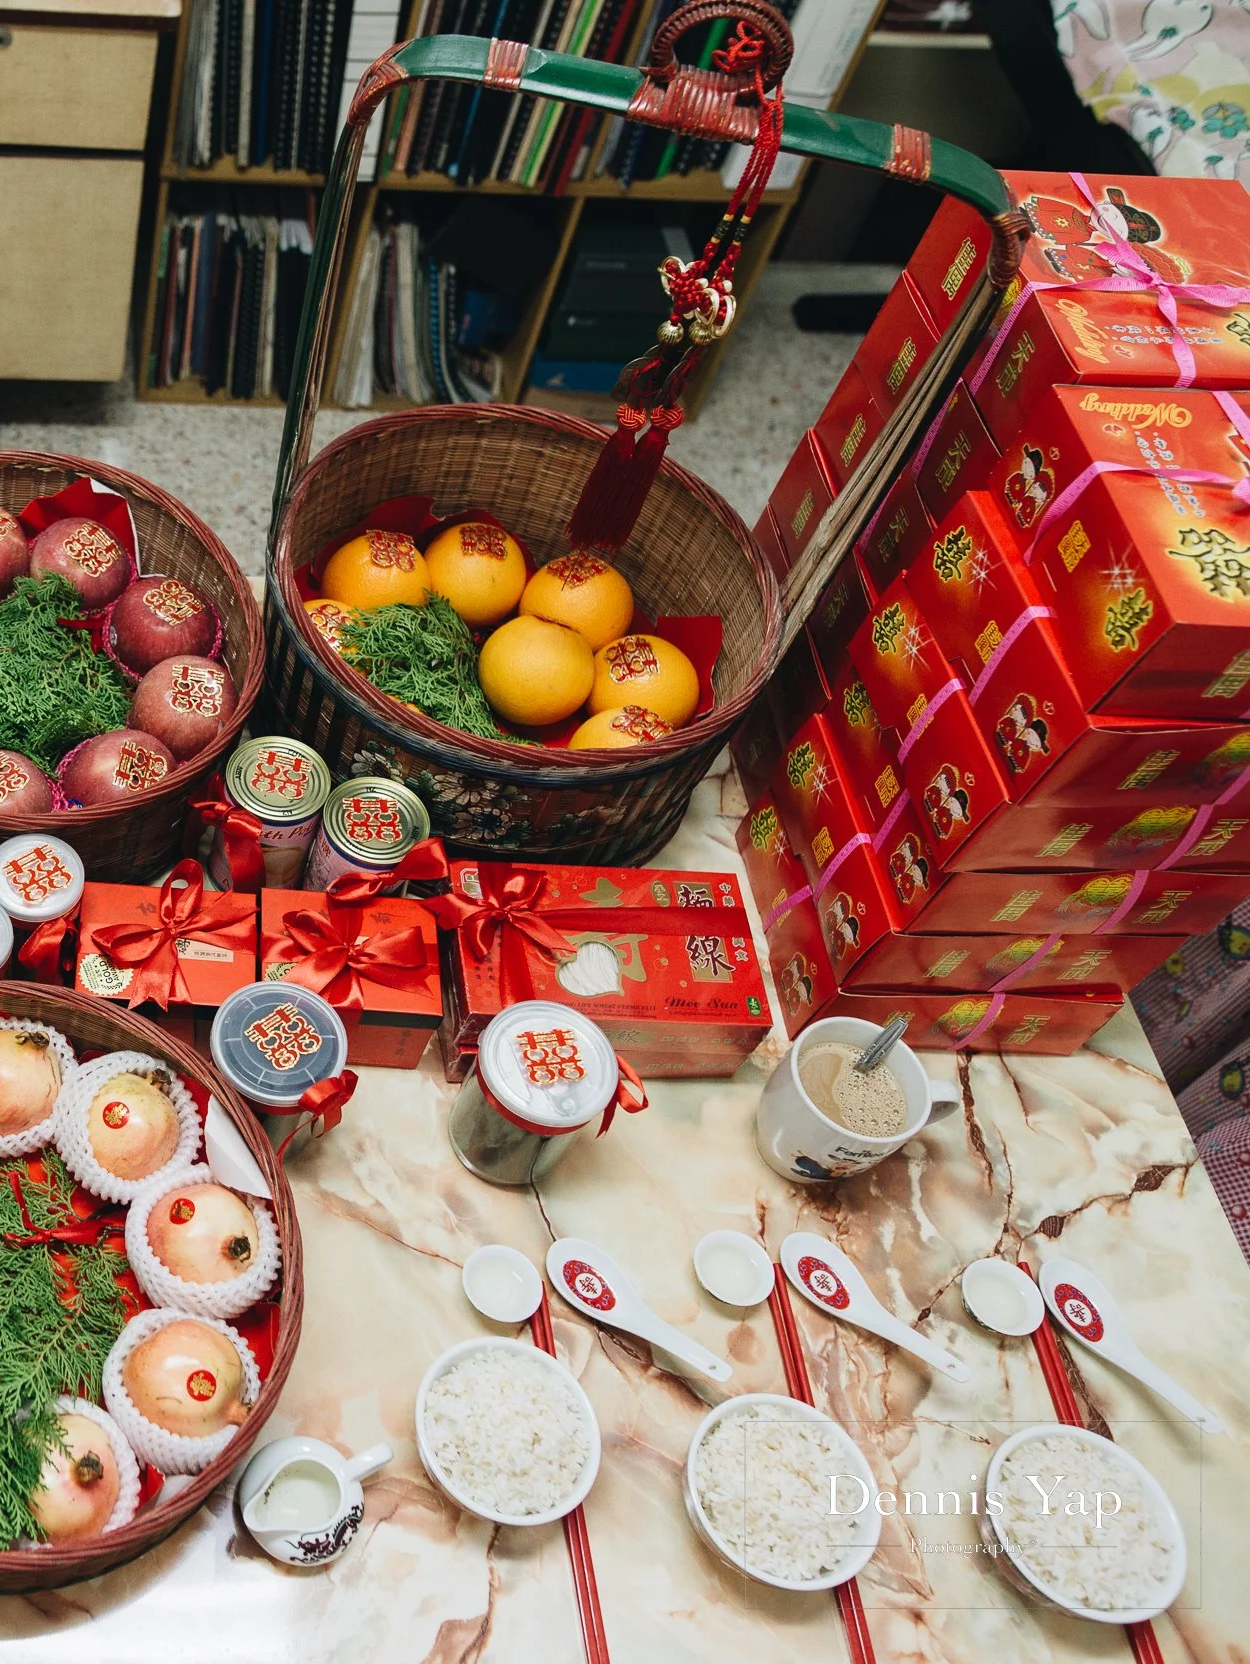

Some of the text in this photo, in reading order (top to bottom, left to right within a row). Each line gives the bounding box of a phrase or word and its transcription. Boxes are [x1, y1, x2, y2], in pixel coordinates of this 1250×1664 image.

[1080, 393, 1192, 429] Wedding
[99, 960, 114, 984] GOLD
[665, 997, 739, 1009] Mee Sua
